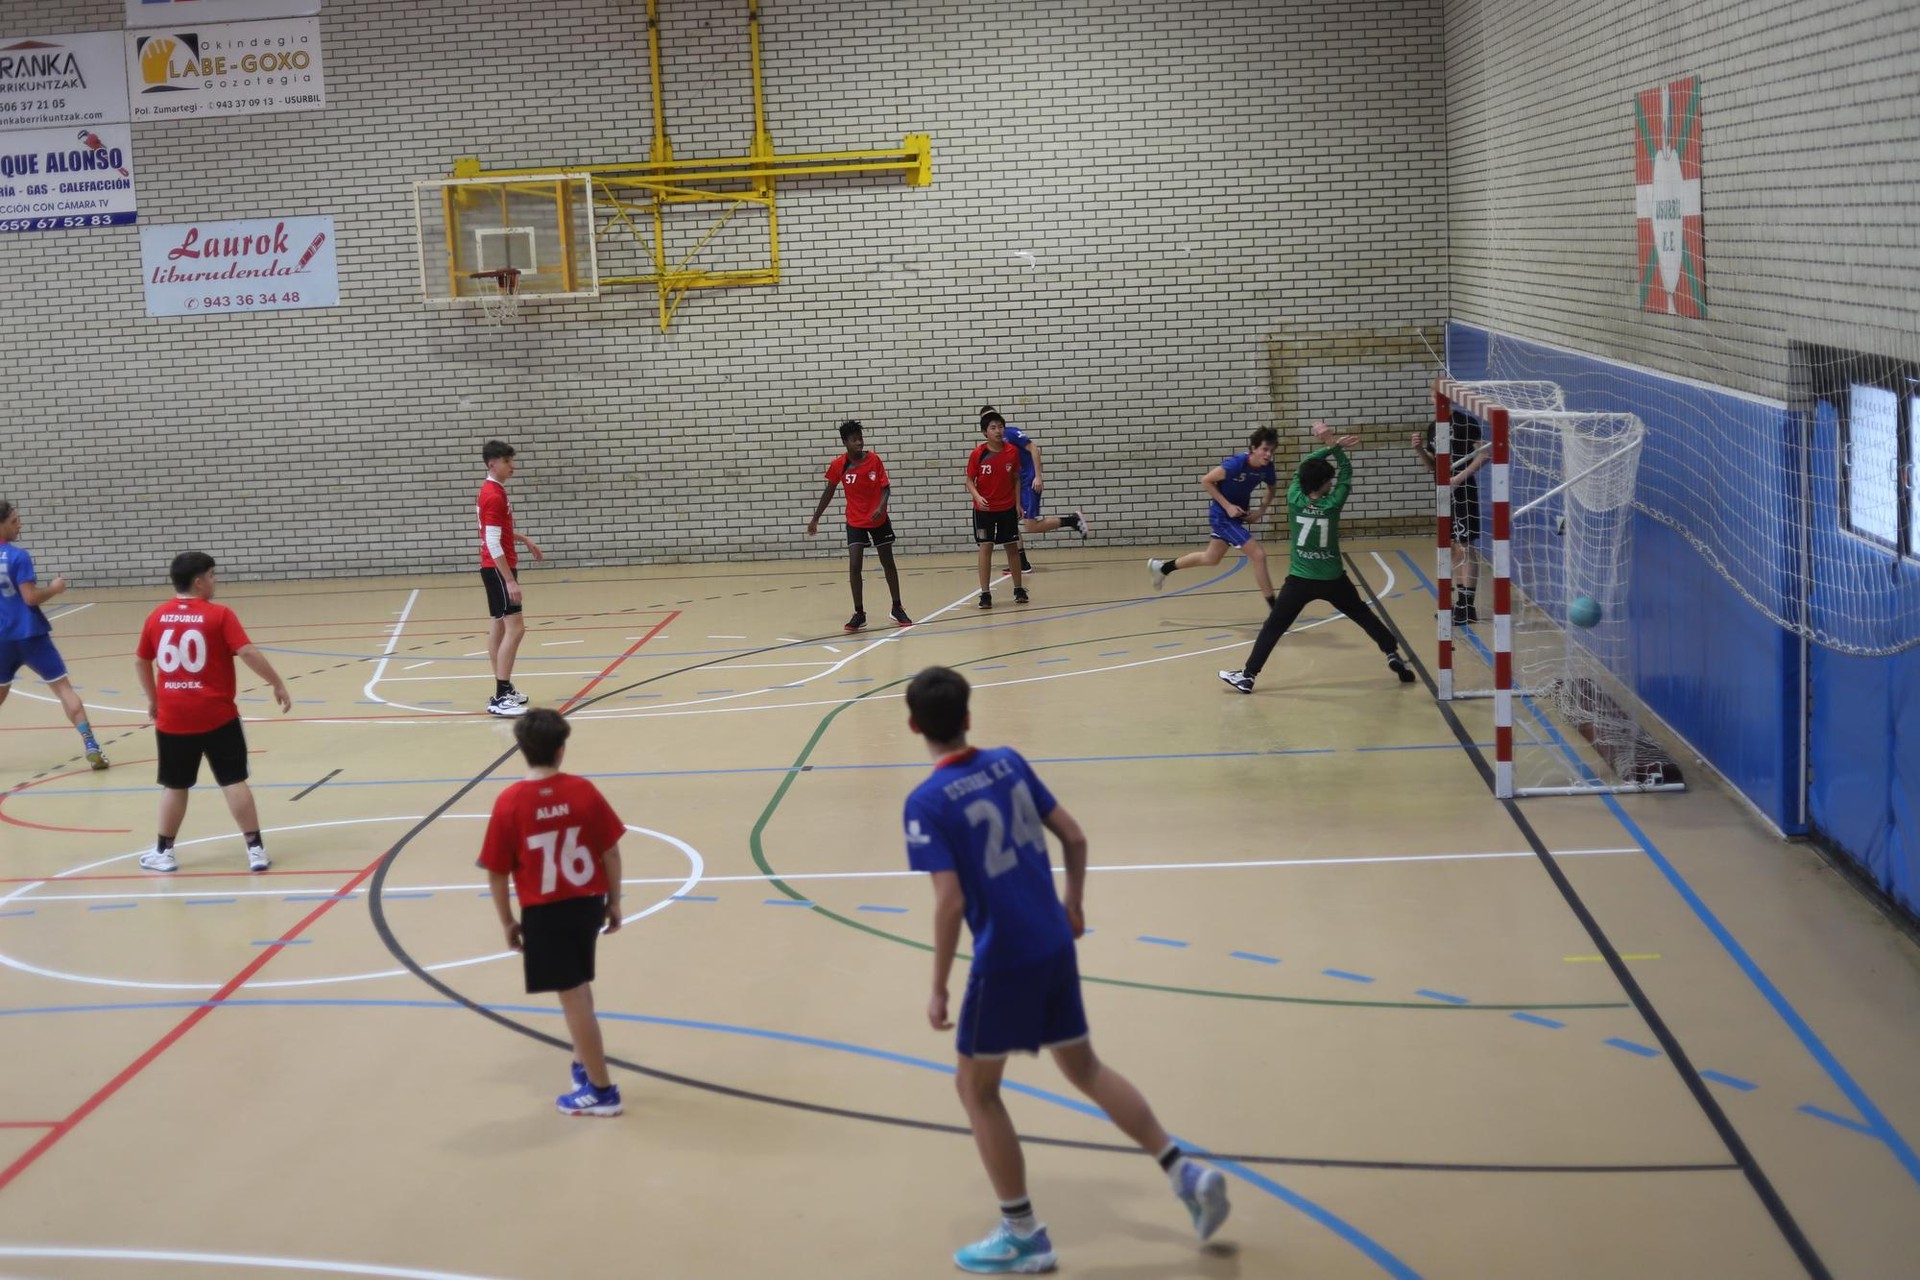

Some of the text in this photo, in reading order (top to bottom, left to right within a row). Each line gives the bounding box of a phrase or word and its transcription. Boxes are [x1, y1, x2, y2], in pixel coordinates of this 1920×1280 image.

[201, 35, 308, 50] Okindegia
[0, 52, 87, 89] RANKA
[169, 50, 310, 79] LABE-GOXO
[0, 79, 79, 93] RRIKUNTZAK
[204, 74, 311, 89] Gozotegia
[20, 101, 33, 111] 37
[37, 100, 48, 110] 21
[52, 98, 66, 109] 05
[153, 103, 198, 115] Zumartegi
[216, 101, 233, 109] 943
[235, 99, 247, 108] 37
[248, 98, 260, 107] 09
[263, 97, 274, 106] 13
[284, 94, 321, 104] USURBIL
[0, 147, 123, 178] QUE ALONSO
[27, 184, 48, 195] GAS
[59, 178, 131, 193] CALEFACCIÓN
[33, 203, 55, 212] CON
[99, 199, 109, 208] TV
[0, 215, 112, 231] 659 67 52 83
[168, 221, 289, 261] Laurok
[151, 259, 293, 284] liburudenda
[203, 291, 300, 308] 943 36 34 48
[981, 464, 992, 475] 73
[845, 473, 857, 484] 57
[1296, 515, 1329, 548] 71
[160, 614, 204, 623] AIZPURUA
[157, 629, 207, 673] 60
[536, 803, 570, 820] ALAN
[963, 779, 1047, 879] 24
[526, 826, 596, 895] 76
